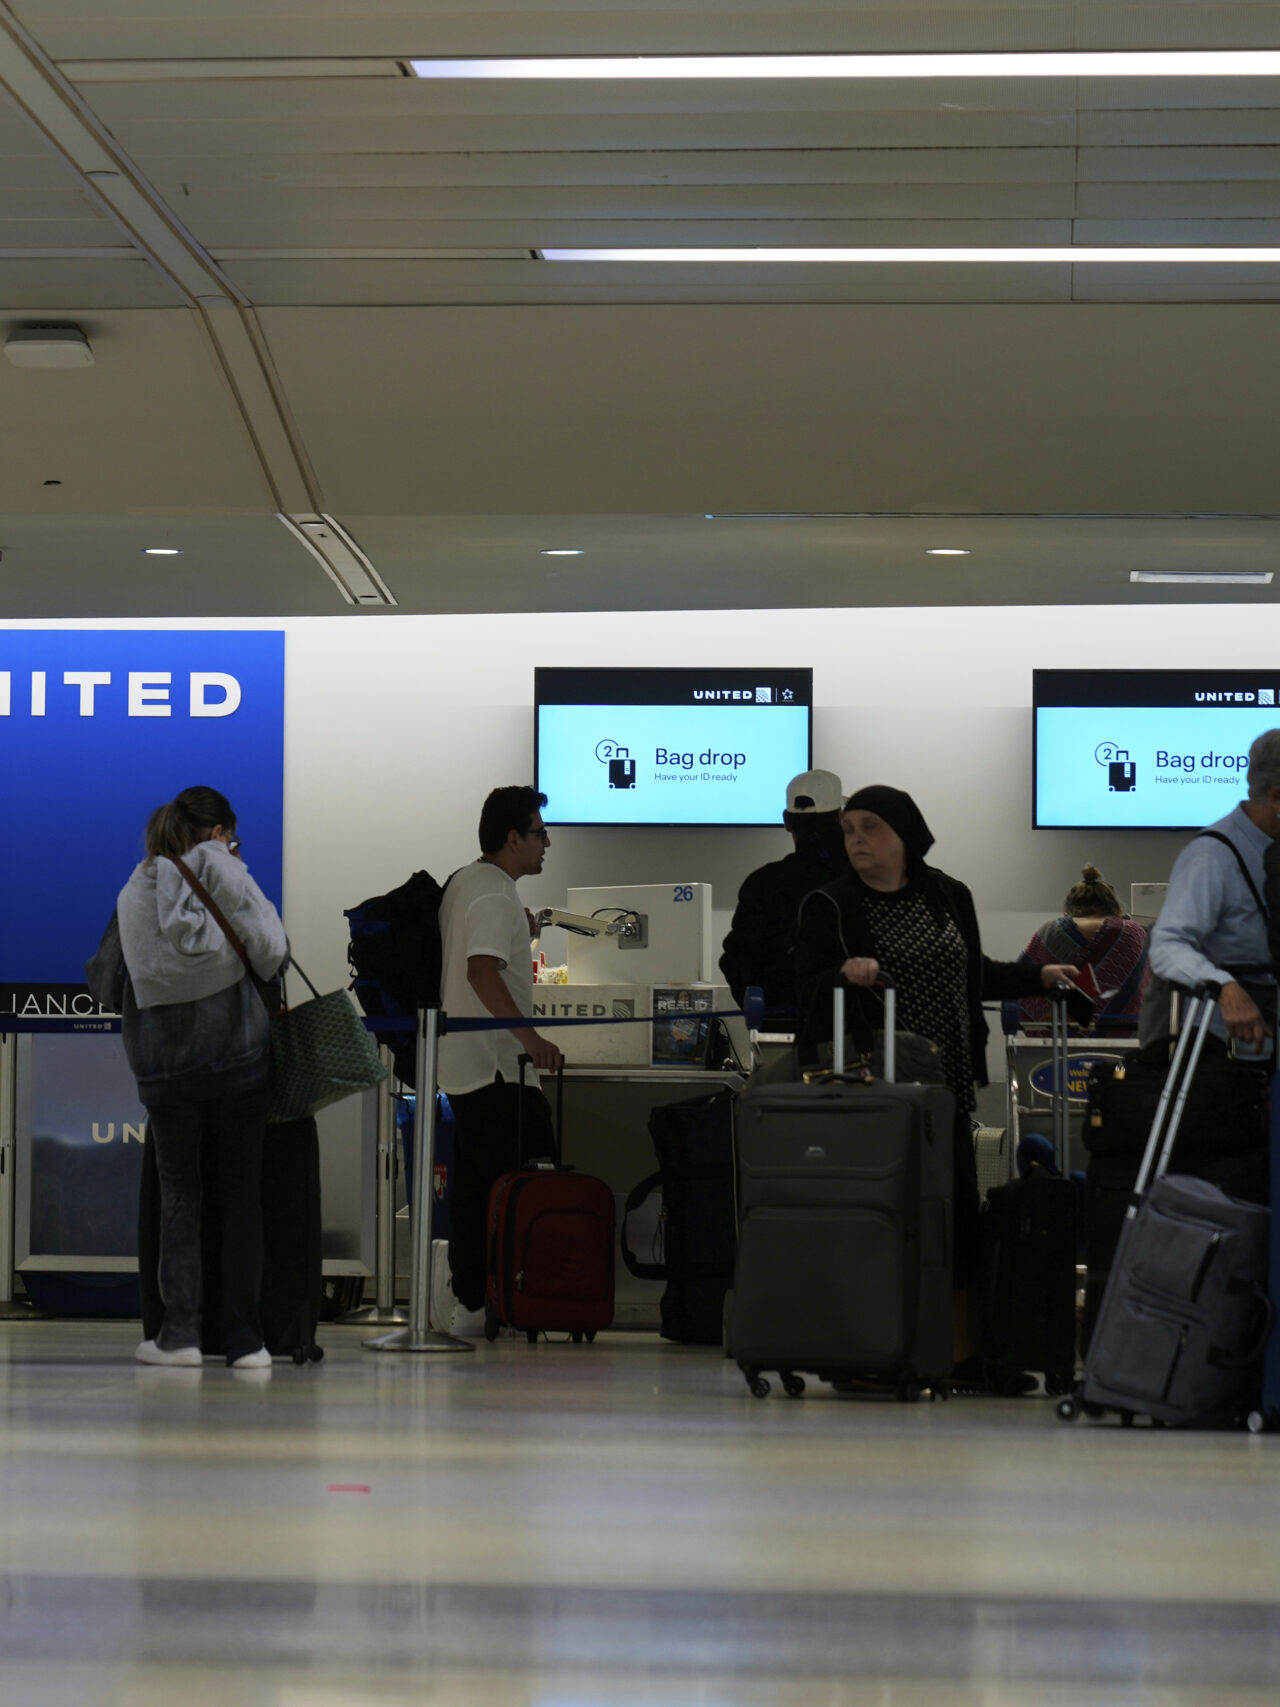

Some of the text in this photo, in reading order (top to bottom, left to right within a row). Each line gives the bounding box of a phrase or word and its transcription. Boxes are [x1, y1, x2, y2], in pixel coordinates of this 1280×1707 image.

[693, 690, 752, 699] UNITED
[1195, 692, 1255, 701] UNITED
[604, 745, 612, 757] 2
[1103, 748, 1112, 760] 2
[655, 748, 746, 769] Bag drop
[1156, 751, 1249, 773] Bag drop
[654, 773, 738, 782] Have your ID ready
[1155, 776, 1240, 785] Have your ID ready
[673, 886, 693, 902] 26
[533, 1004, 606, 1017] NITED
[658, 1000, 708, 1011] REAL ID
